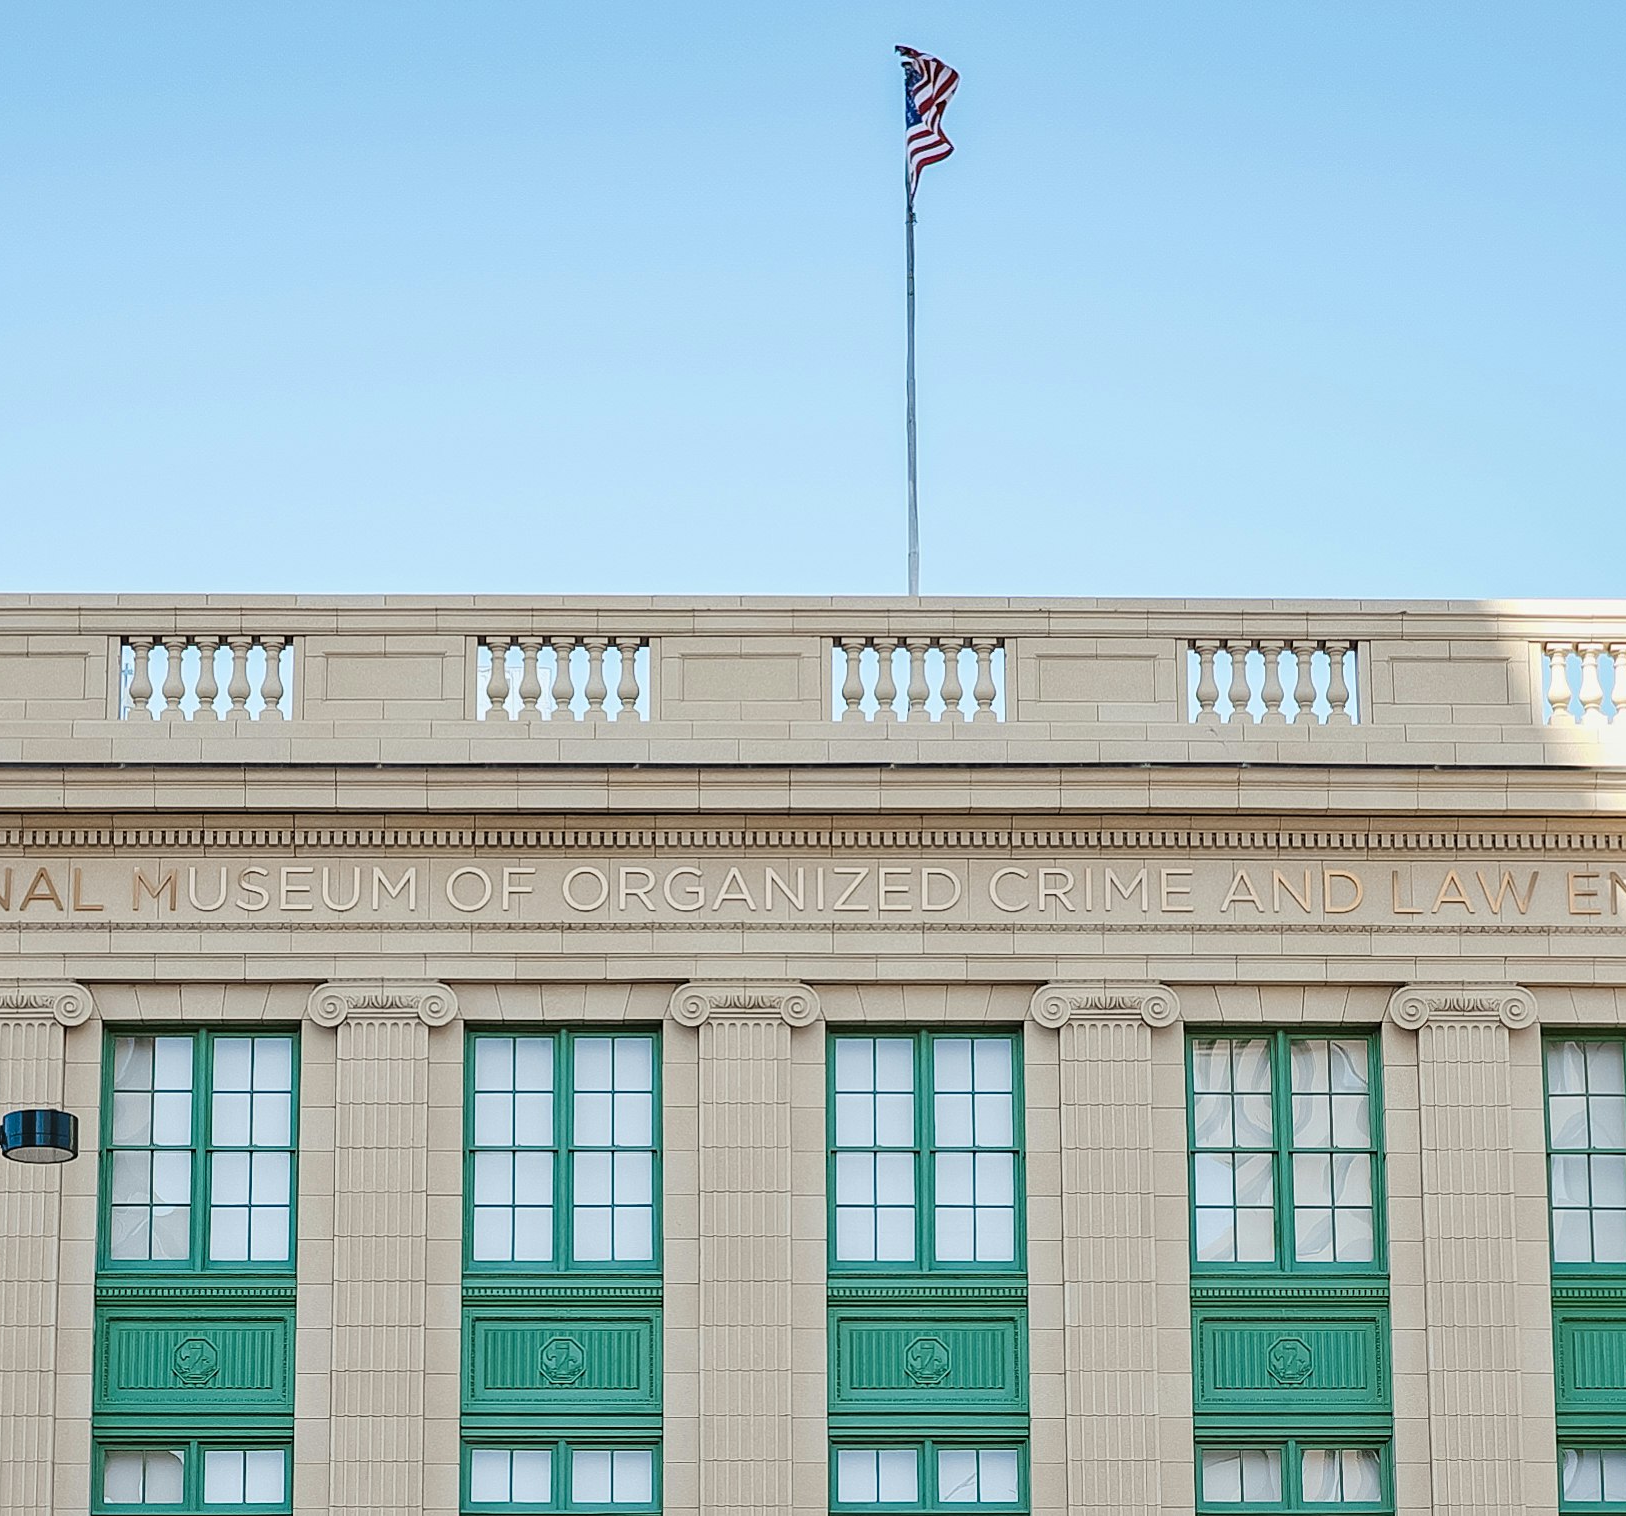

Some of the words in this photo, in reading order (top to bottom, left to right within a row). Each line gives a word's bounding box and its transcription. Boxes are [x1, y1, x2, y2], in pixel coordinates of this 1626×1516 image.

[132, 866, 418, 913] MUSEUM
[444, 866, 537, 913] OF
[562, 866, 961, 913] ORGANIZED
[988, 866, 1195, 913] CRIME
[1222, 868, 1365, 915] AND
[1392, 869, 1539, 915] LAW
